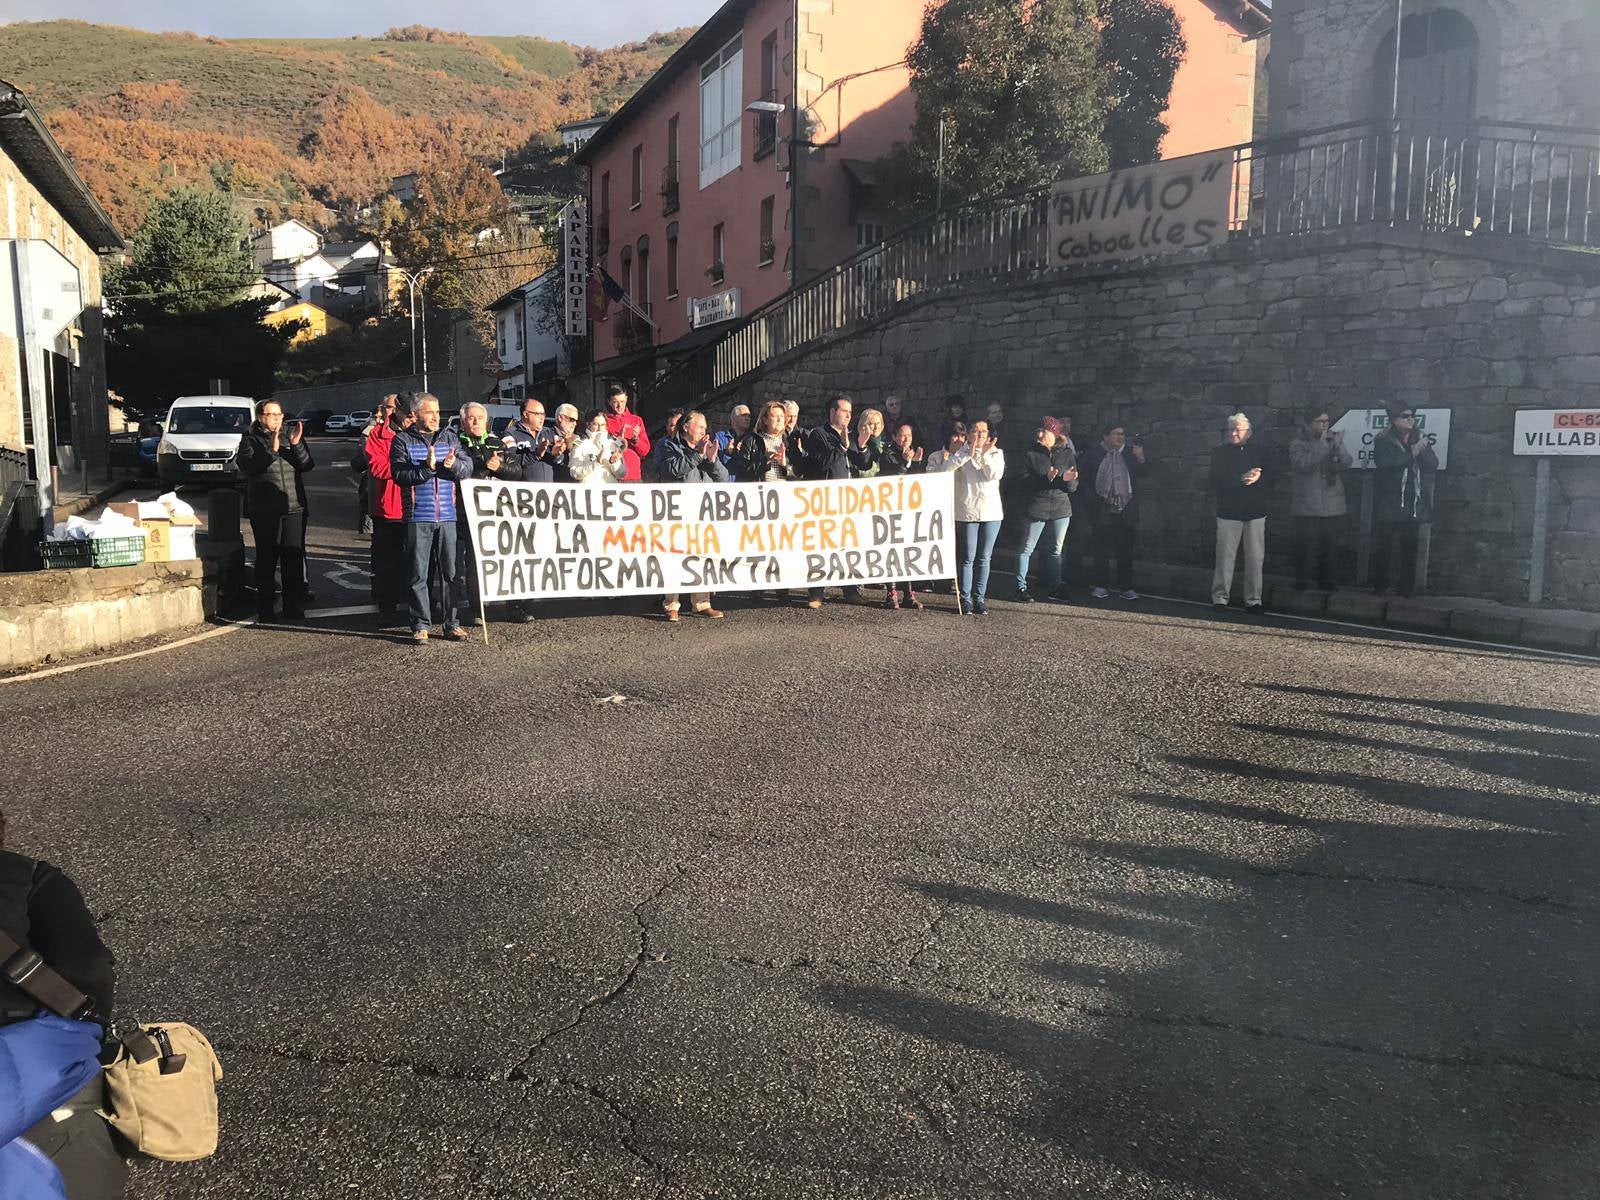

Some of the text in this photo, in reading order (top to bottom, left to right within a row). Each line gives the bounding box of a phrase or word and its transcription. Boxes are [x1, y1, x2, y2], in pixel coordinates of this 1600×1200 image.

[570, 209, 582, 333] APARTHOTEL
[1525, 432, 1600, 446] VILLAB
[474, 485, 639, 521] CABOALLES
[652, 489, 682, 521] DE
[478, 510, 943, 556] CON LA MARCHA MINERA DE LA
[482, 544, 944, 596] PLATAFORMA SANTA BÁRBARA
